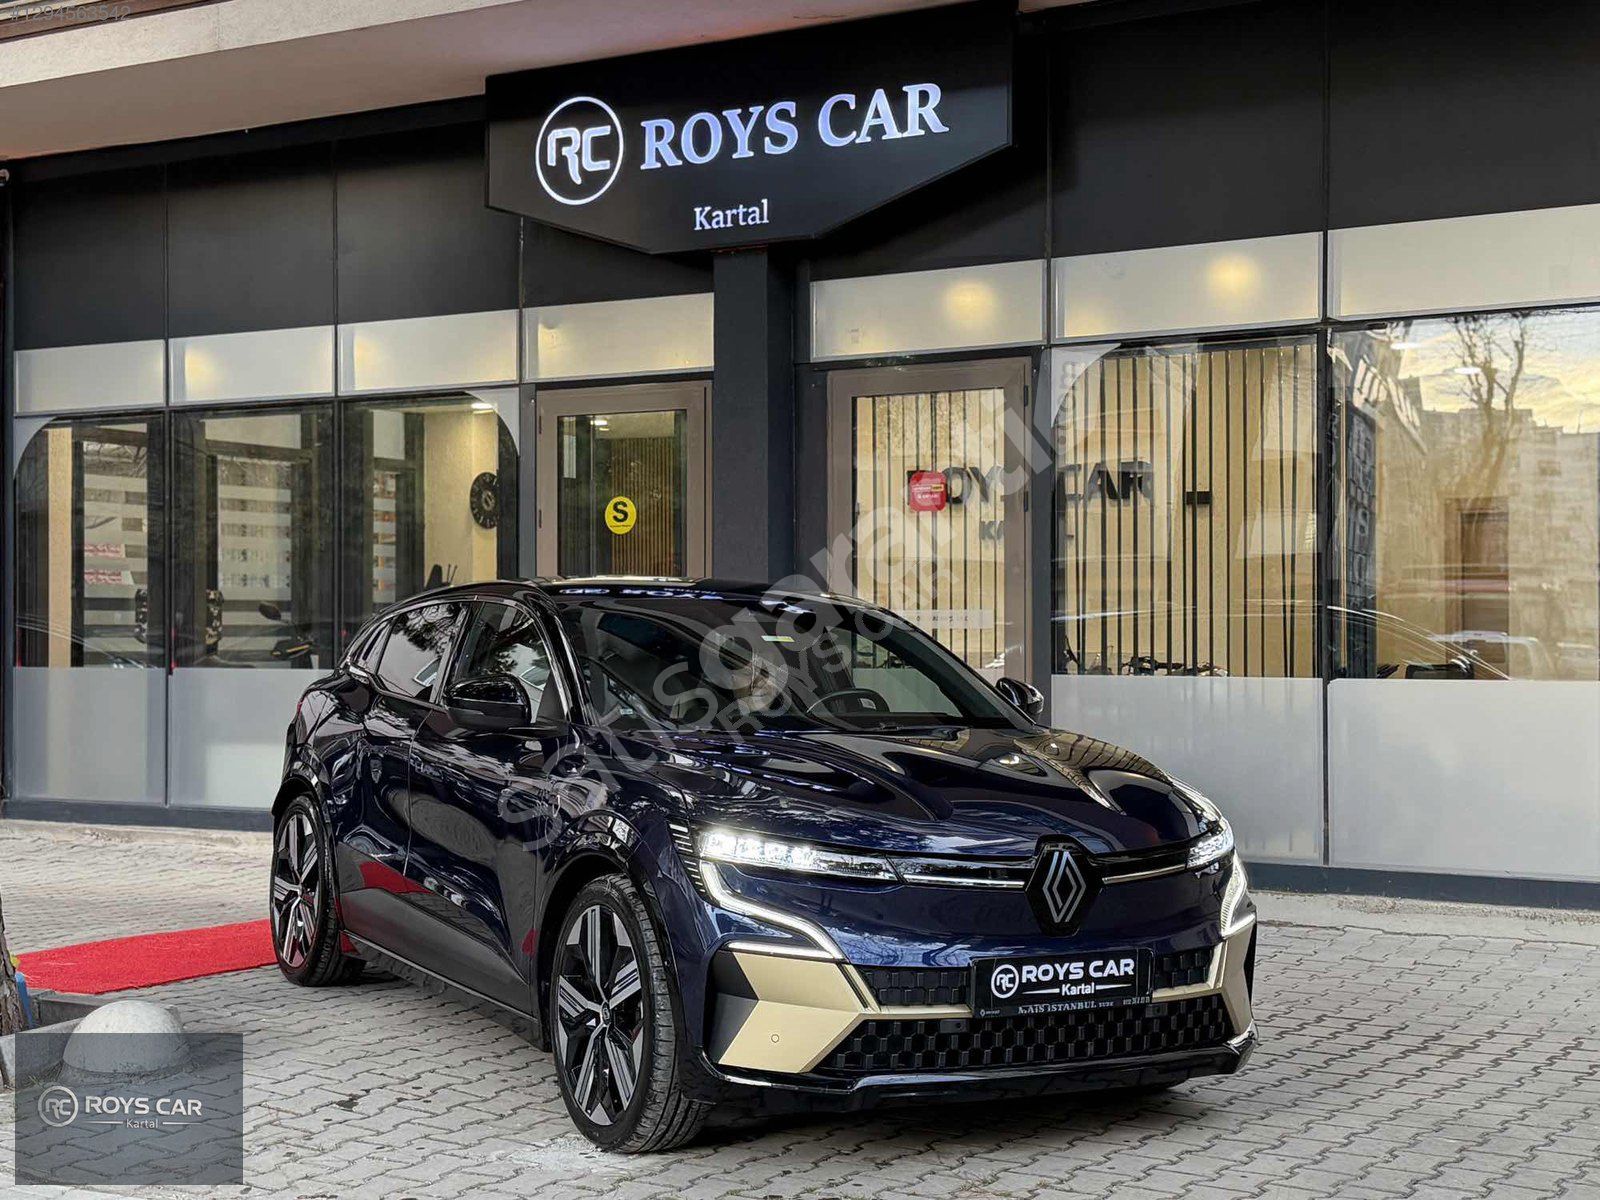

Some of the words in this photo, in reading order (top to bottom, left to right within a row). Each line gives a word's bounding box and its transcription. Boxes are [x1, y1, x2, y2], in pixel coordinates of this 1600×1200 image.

[640, 101, 798, 171] ROYS
[818, 83, 949, 148] CAR
[693, 198, 770, 232] Kartal
[612, 501, 629, 522] S
[1021, 961, 1084, 983] ROYS
[1088, 958, 1135, 978] CAR
[1061, 982, 1095, 996] Kartal
